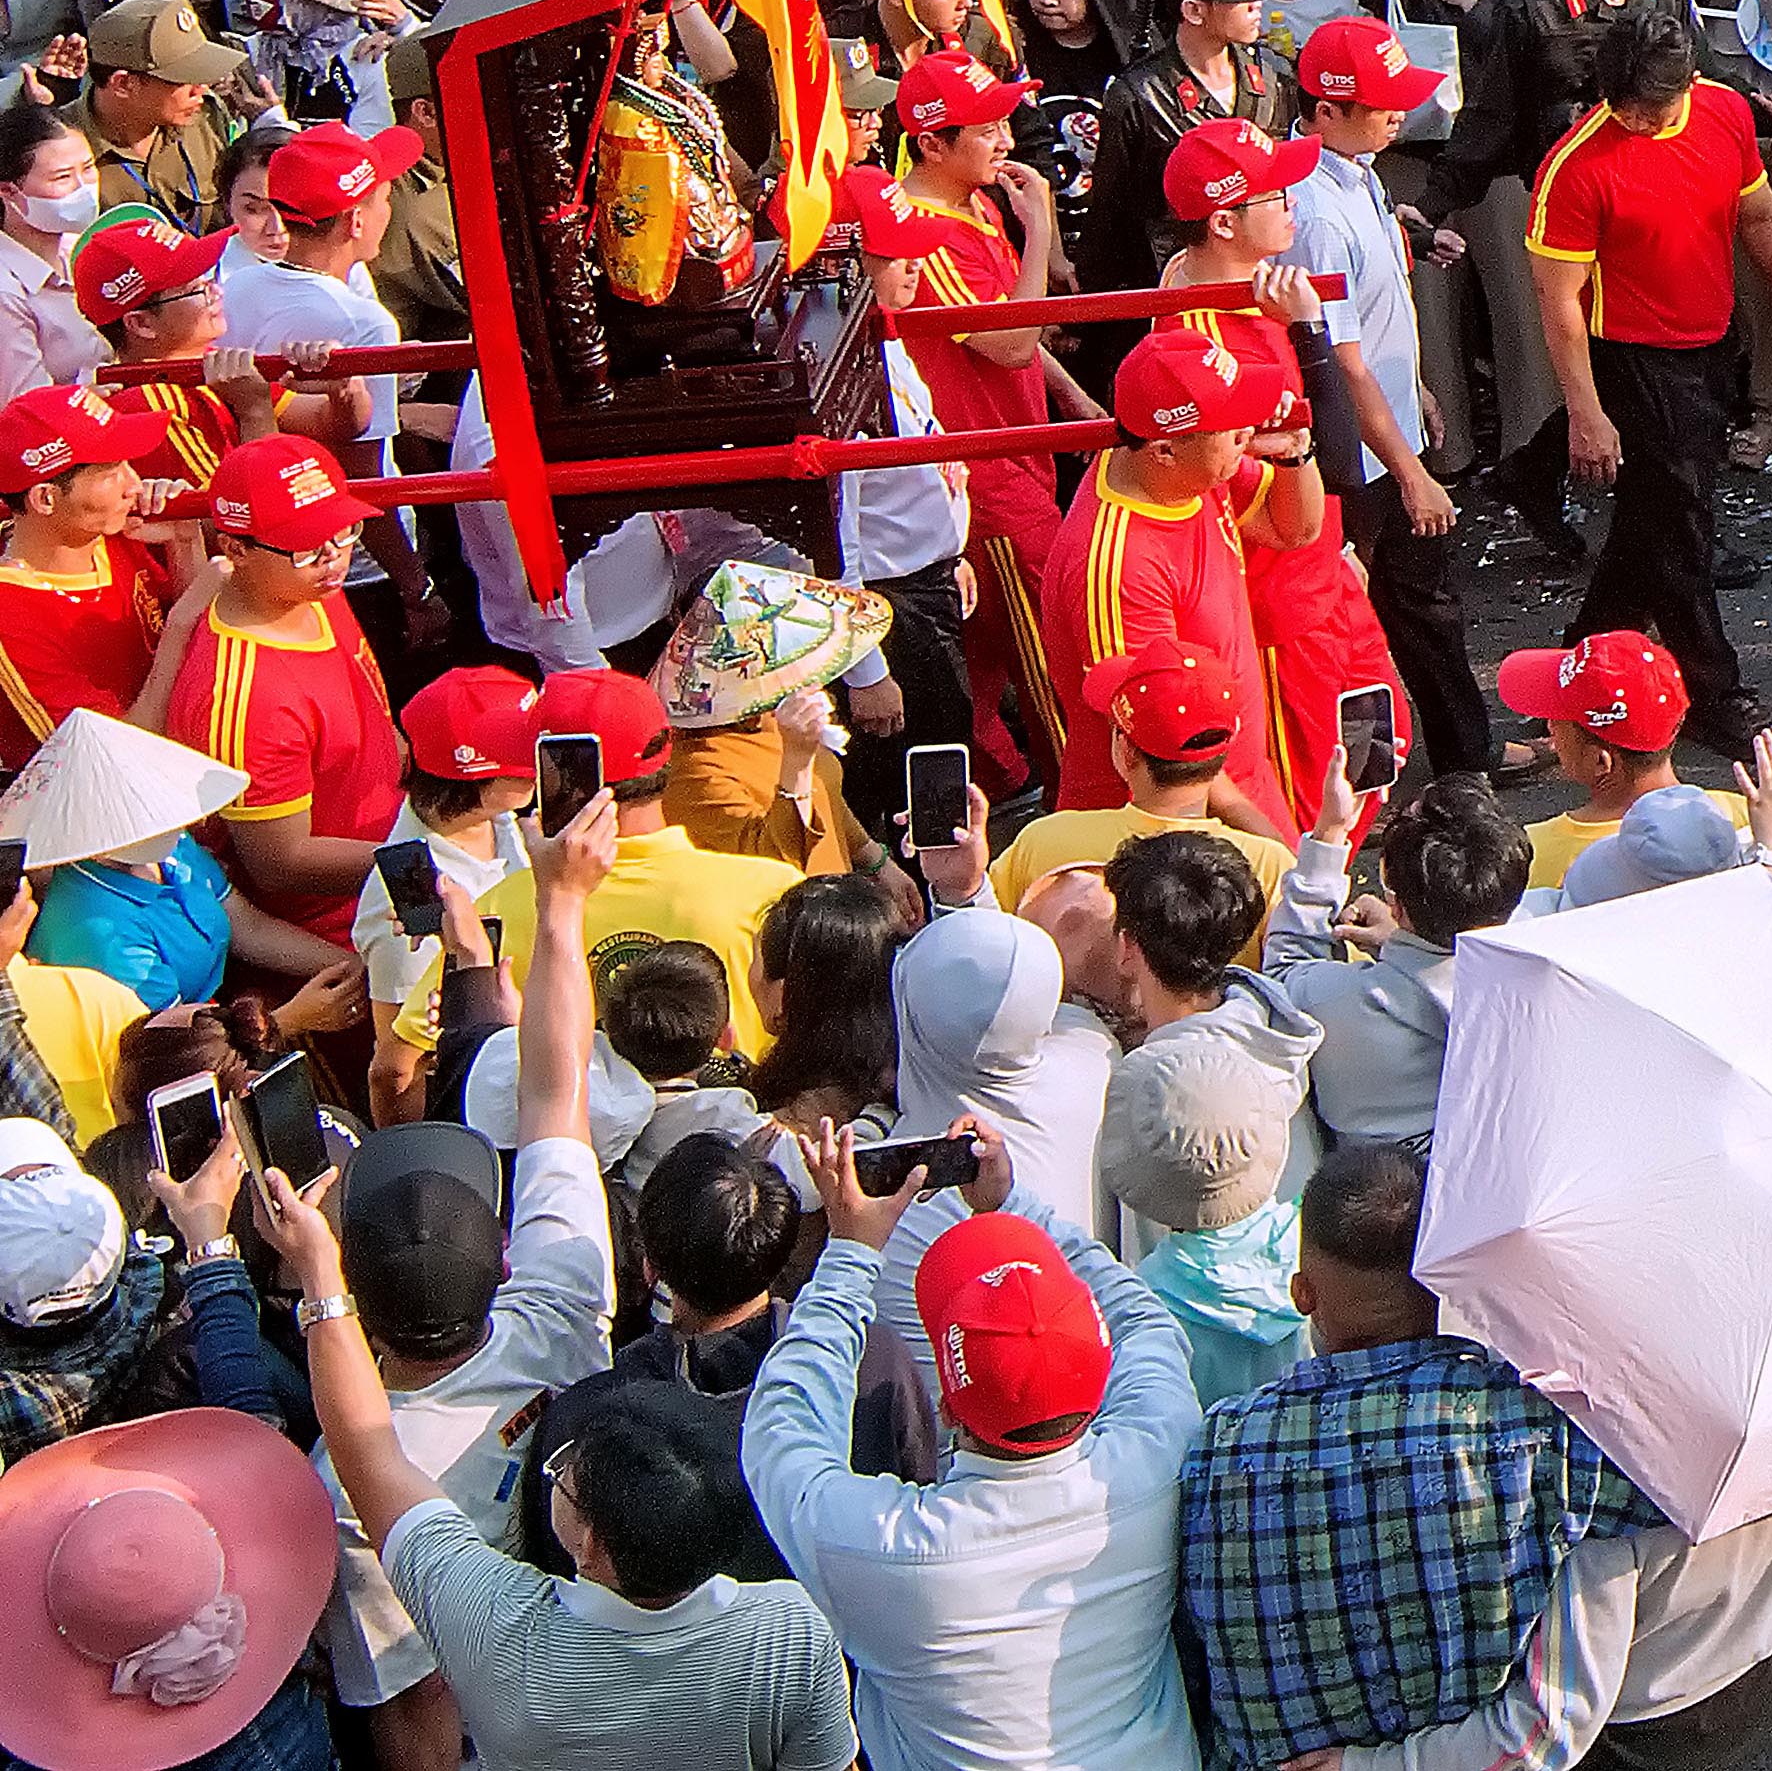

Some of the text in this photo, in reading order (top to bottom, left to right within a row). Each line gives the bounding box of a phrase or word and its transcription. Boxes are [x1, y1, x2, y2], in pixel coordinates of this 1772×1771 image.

[1332, 75, 1356, 85] TDC
[924, 98, 945, 113] TDC
[1219, 170, 1244, 191] TDC
[116, 268, 139, 287] TDC
[1171, 402, 1197, 419] TDC
[39, 437, 67, 455] TDC
[229, 501, 251, 514] TDC
